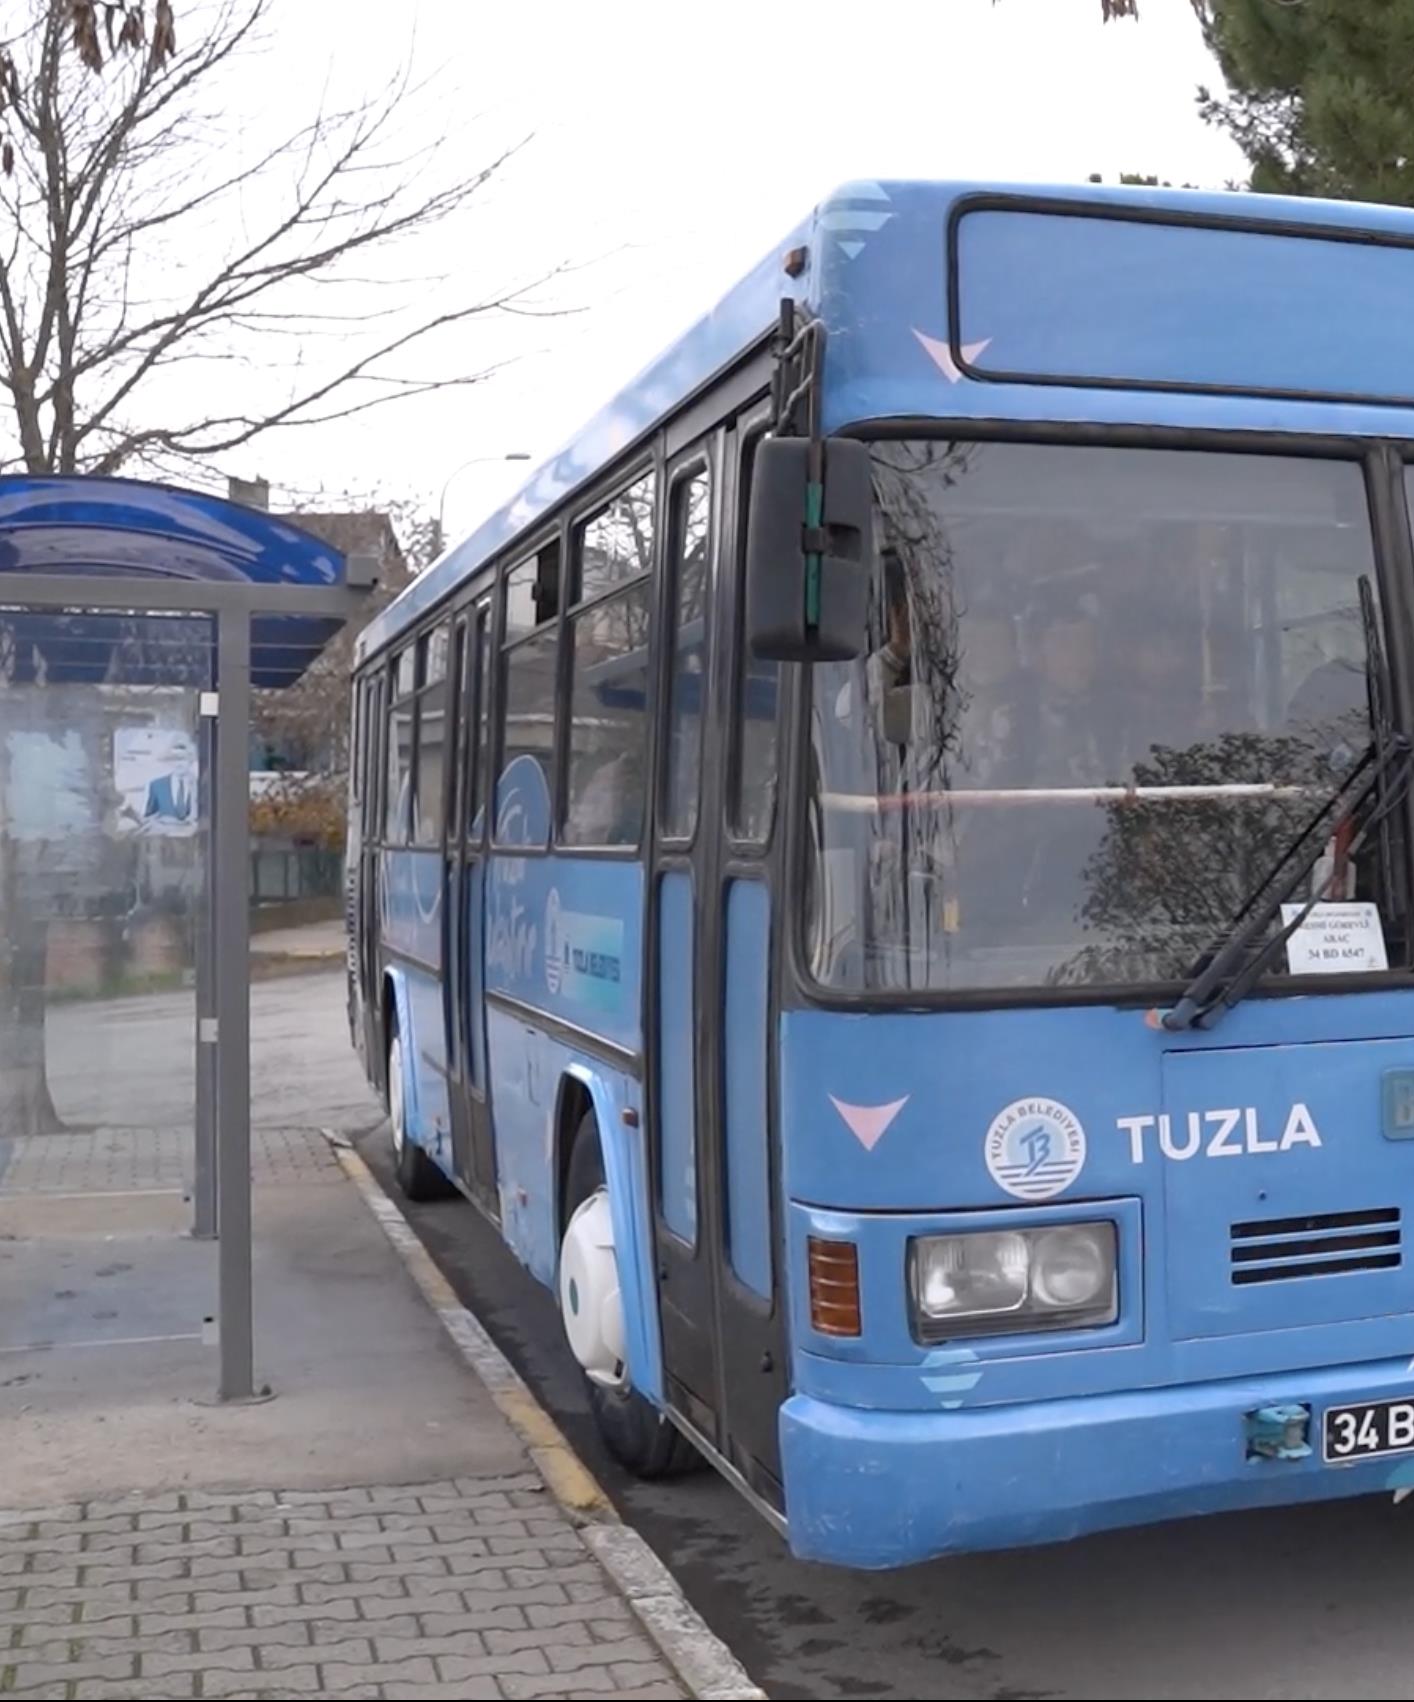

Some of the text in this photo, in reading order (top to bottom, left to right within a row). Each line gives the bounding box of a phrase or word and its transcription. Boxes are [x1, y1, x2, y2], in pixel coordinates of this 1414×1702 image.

[991, 1114, 1017, 1160] TUZLA
[1116, 1103, 1323, 1164] TUZLA
[1333, 1410, 1379, 1454] 34
